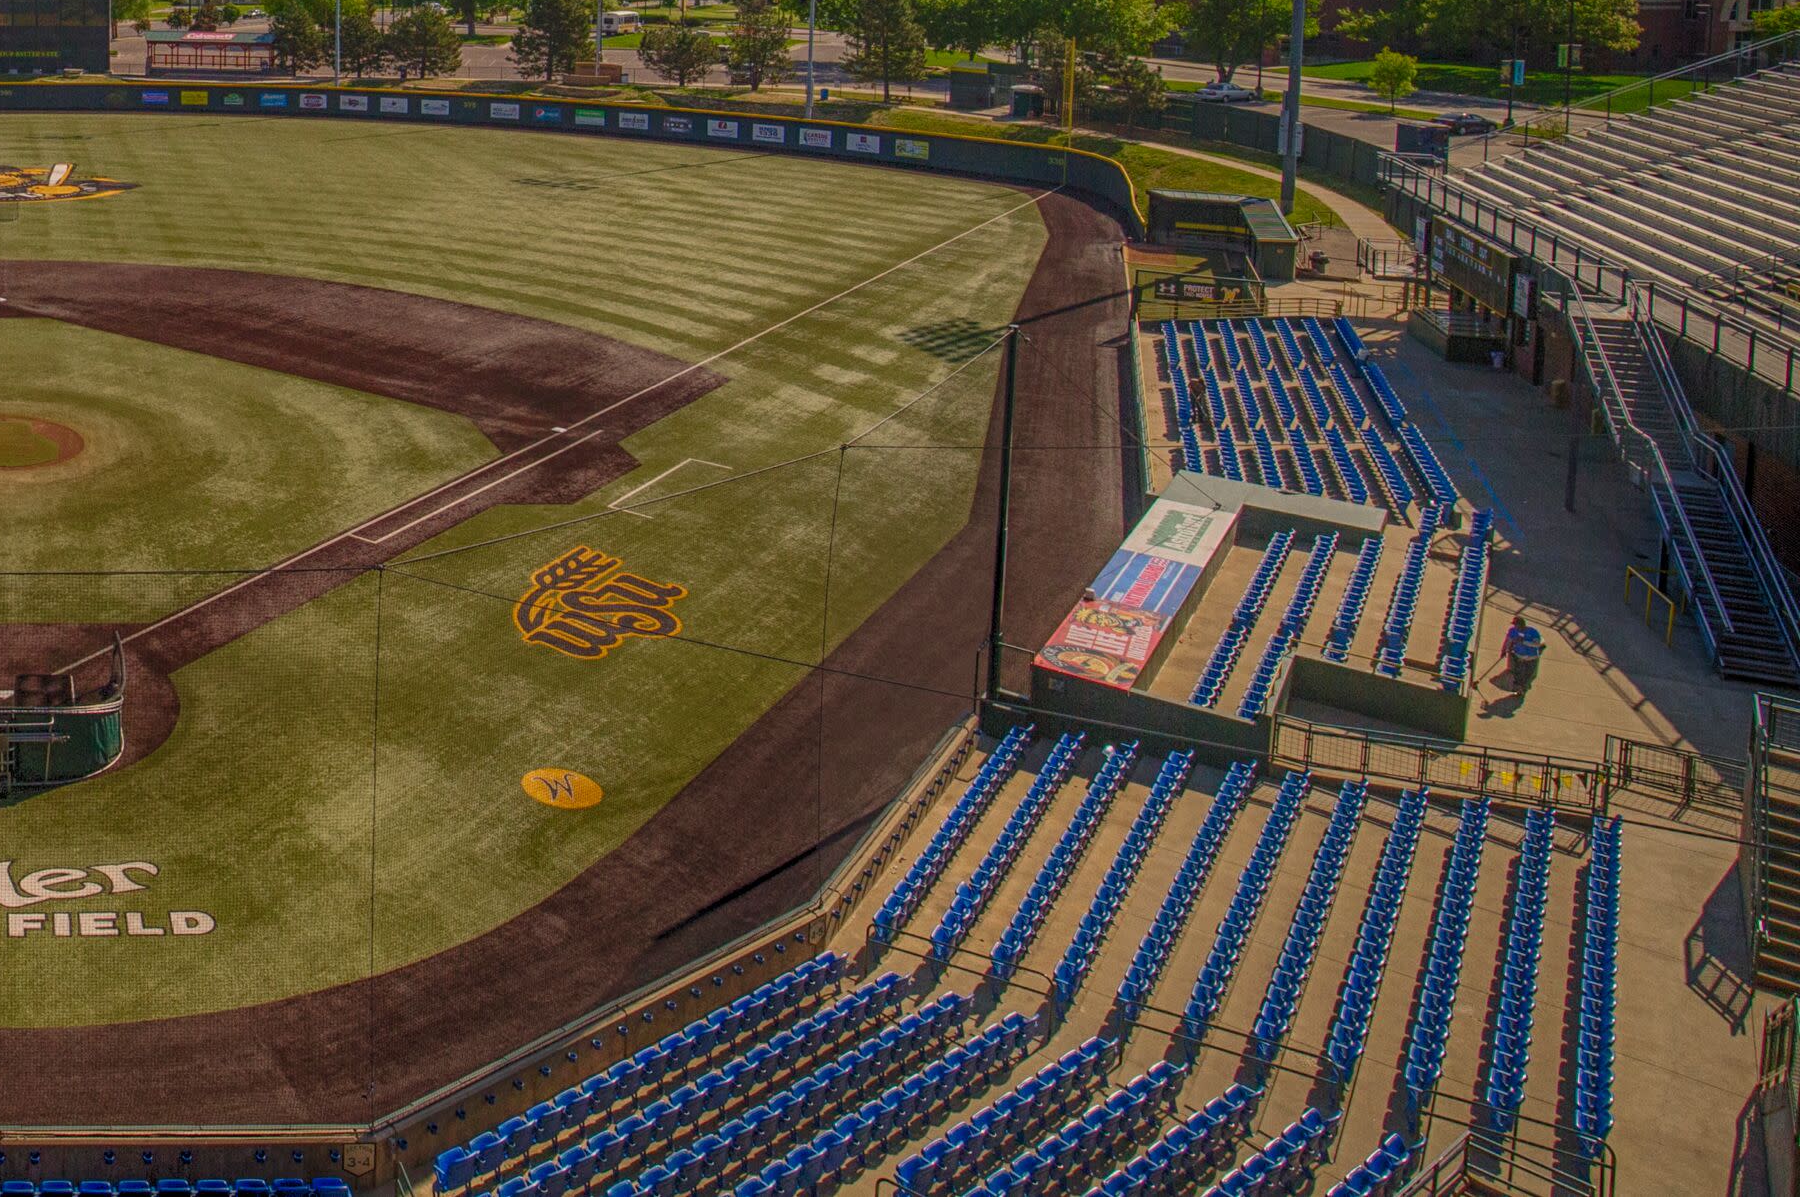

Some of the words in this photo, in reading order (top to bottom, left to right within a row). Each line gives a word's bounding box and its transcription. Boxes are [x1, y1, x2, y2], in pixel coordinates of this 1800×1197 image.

[1183, 284, 1214, 295] PROTECT
[7, 910, 217, 938] FIELD
[347, 1157, 370, 1168] 3-4
